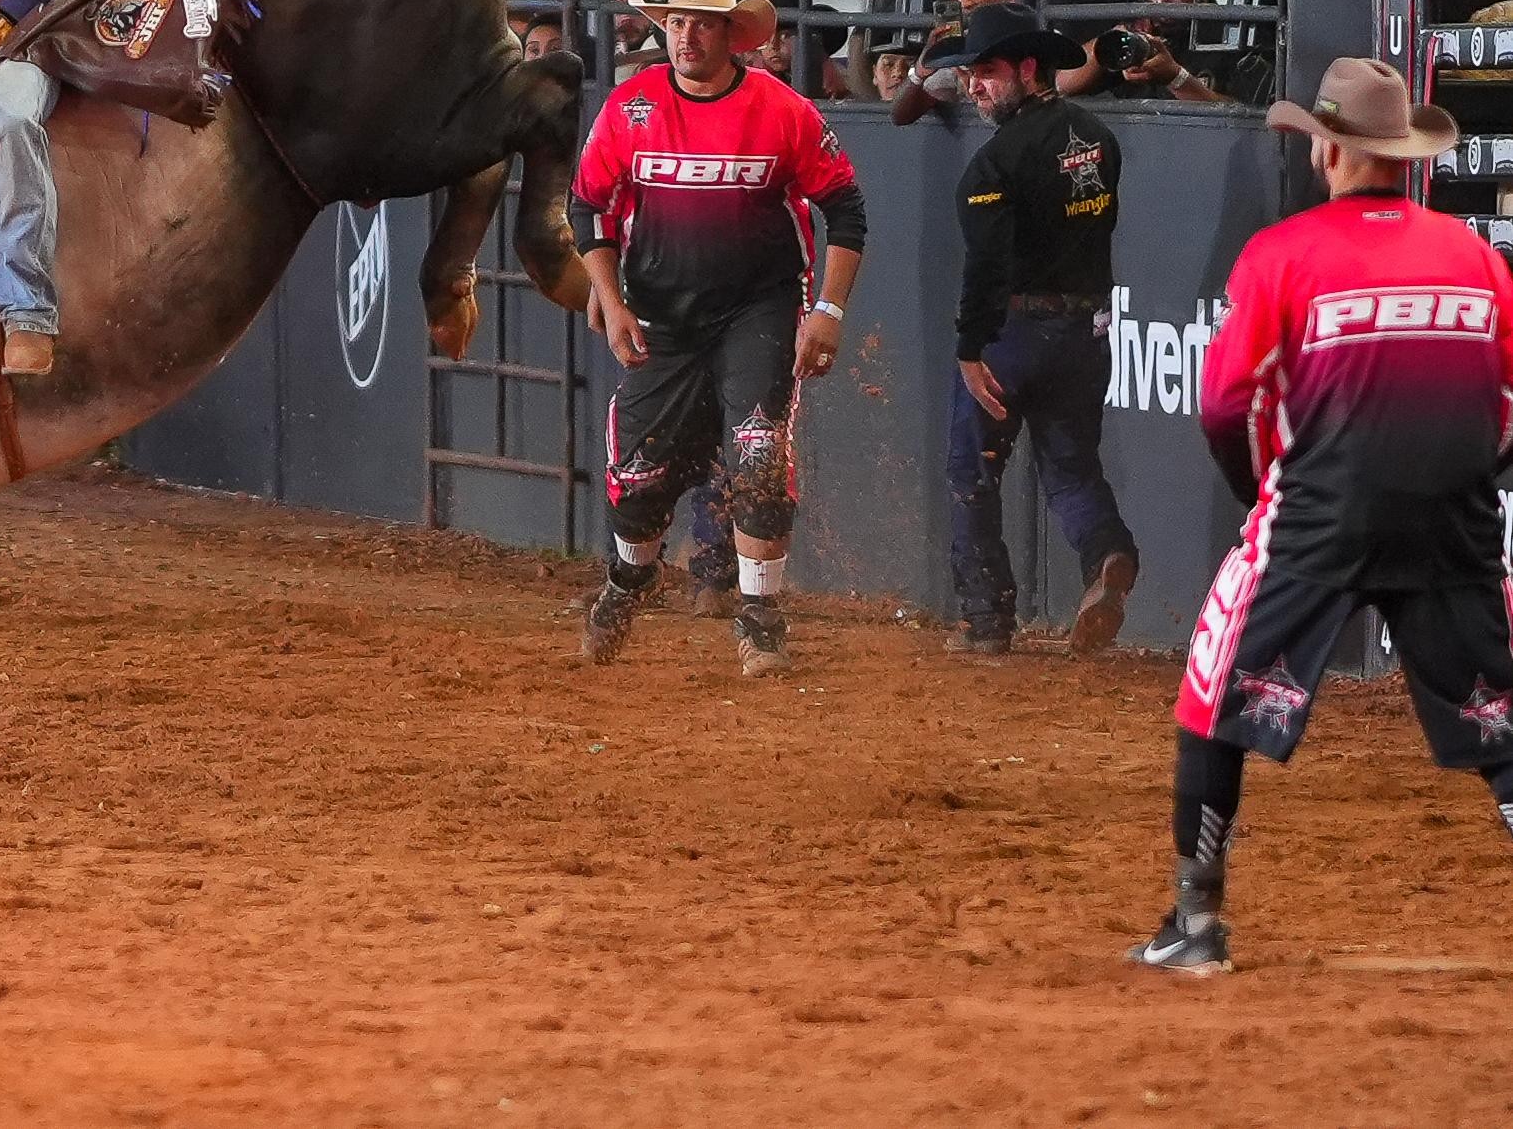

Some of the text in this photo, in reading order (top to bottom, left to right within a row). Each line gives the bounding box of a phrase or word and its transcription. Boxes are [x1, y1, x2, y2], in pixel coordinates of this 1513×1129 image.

[639, 156, 767, 184] PBR
[1315, 294, 1491, 336] PBR
[1104, 285, 1229, 416] divert
